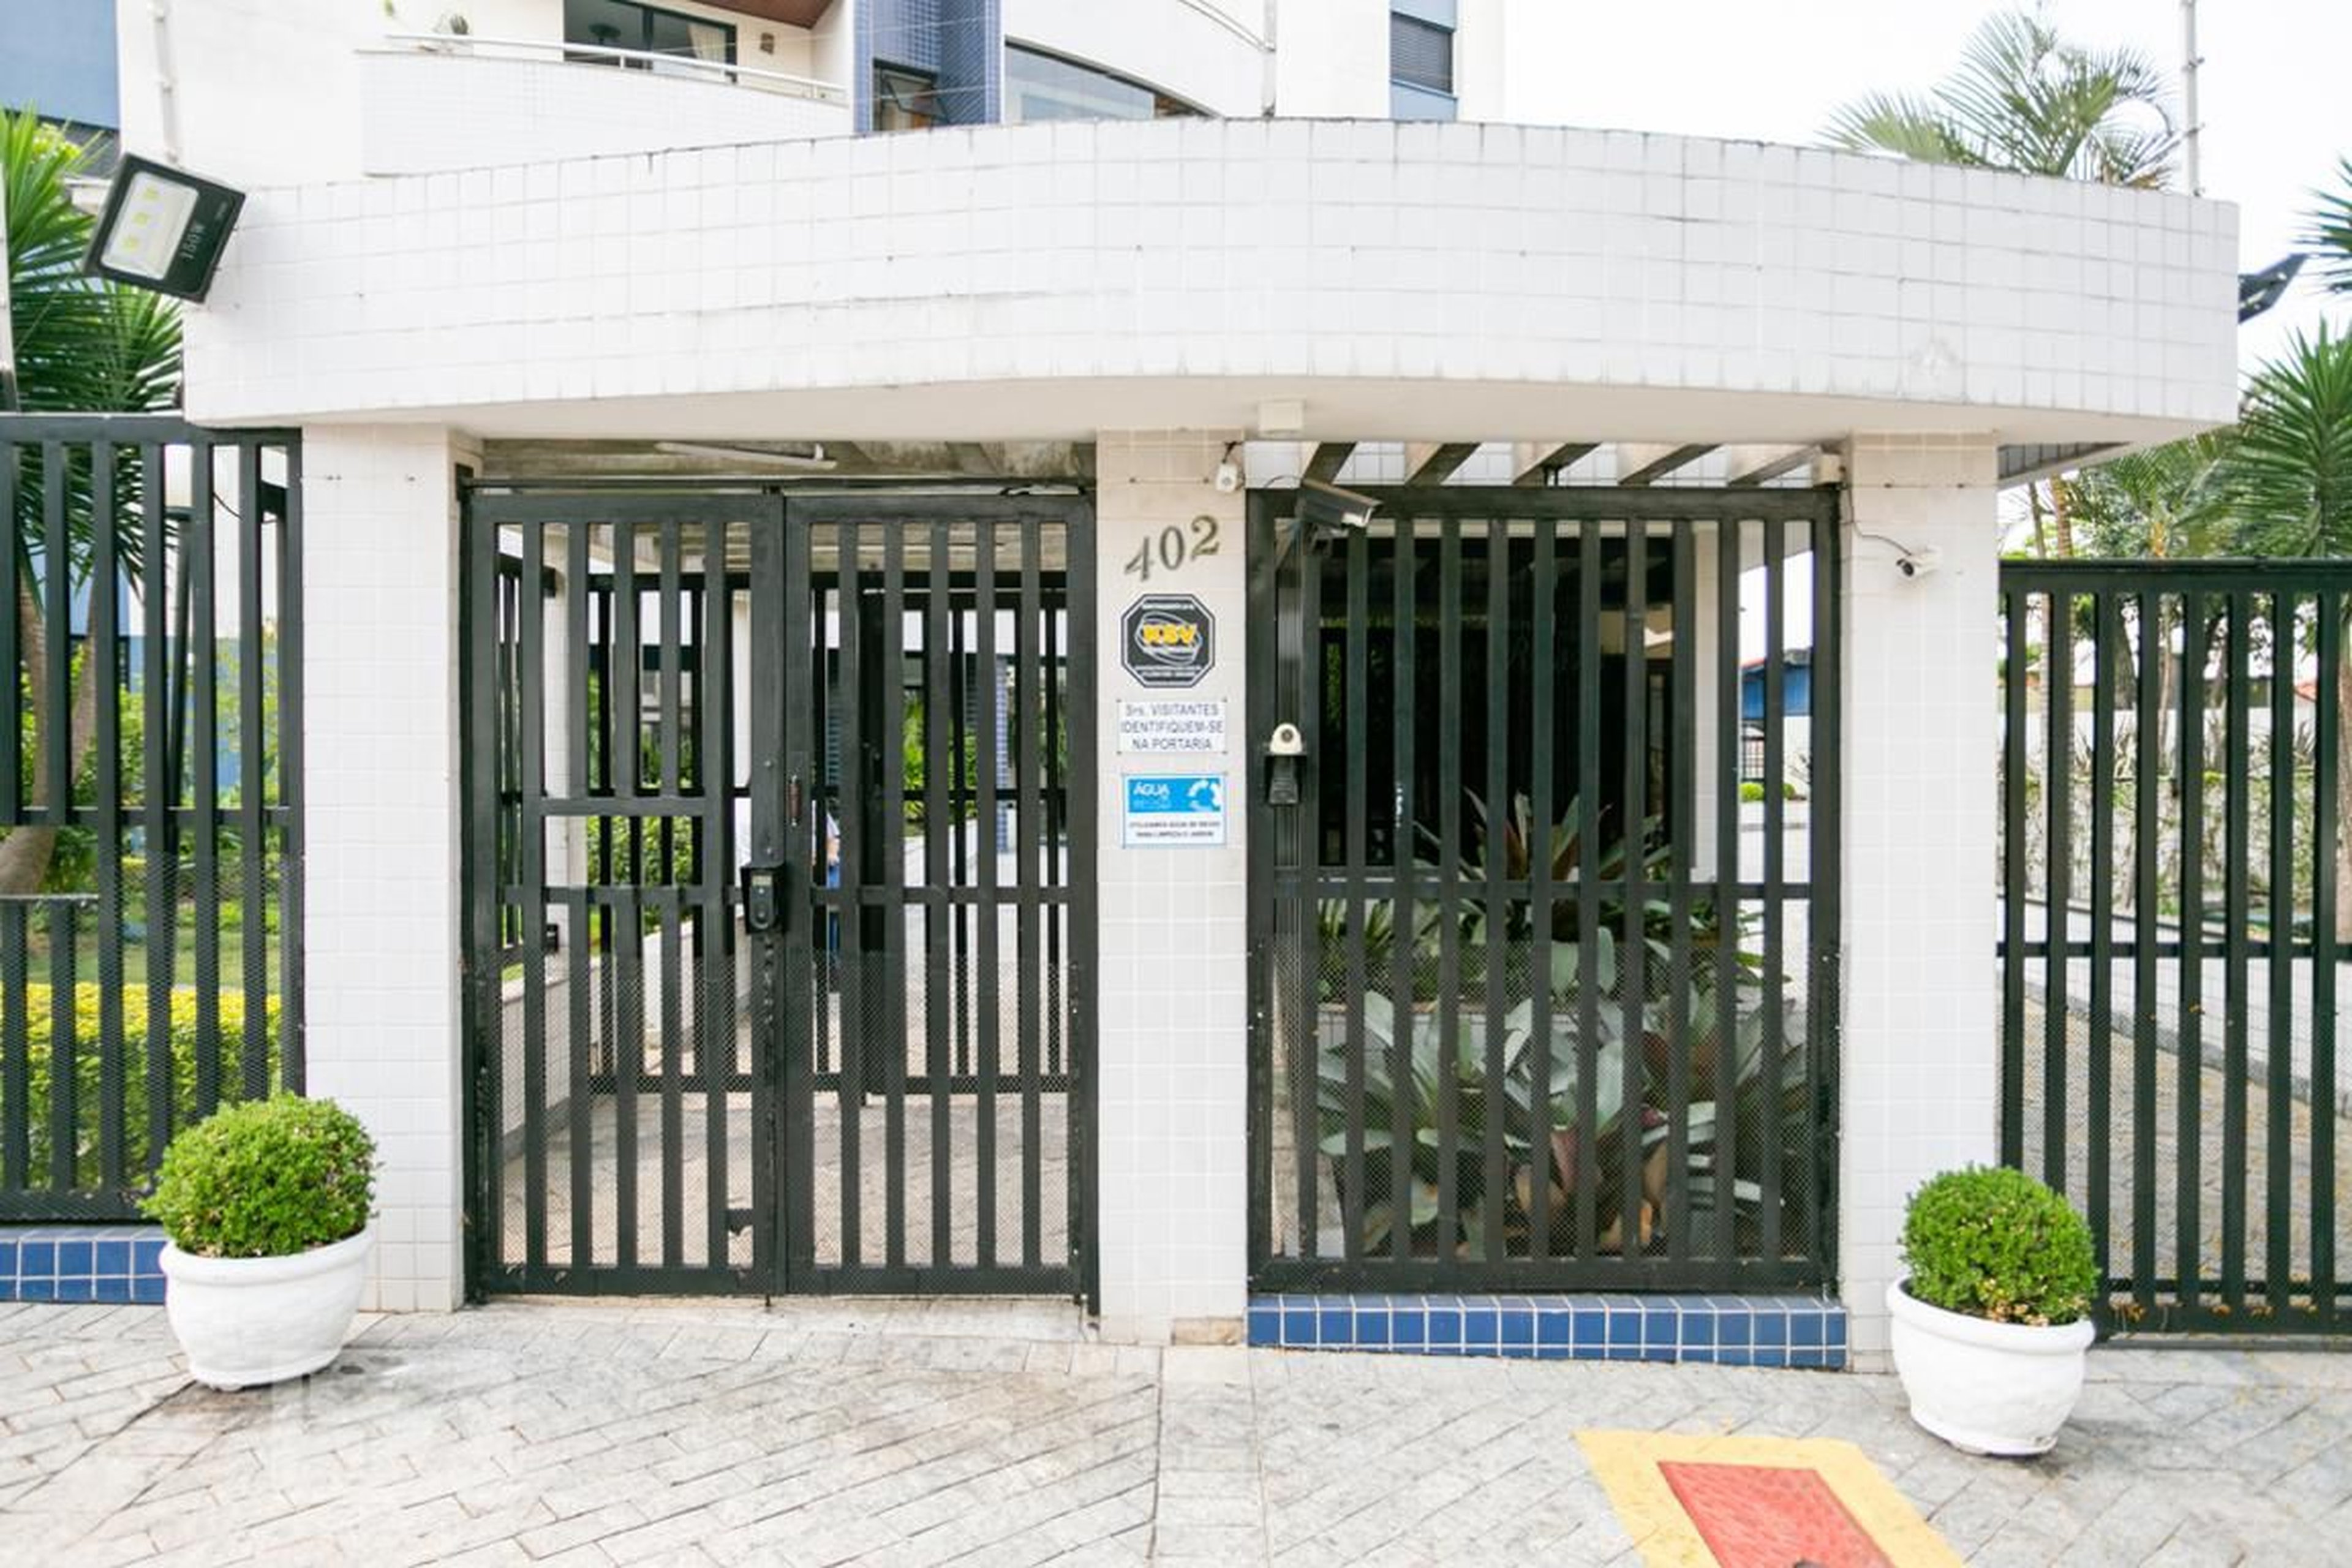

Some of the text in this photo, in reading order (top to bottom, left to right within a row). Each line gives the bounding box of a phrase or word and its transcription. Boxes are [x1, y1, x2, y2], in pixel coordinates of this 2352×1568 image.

[1123, 514, 1220, 581] 402
[1152, 703, 1218, 715] VISITANTES
[1121, 720, 1224, 734] IDENTIFIQUEM-SE
[1133, 738, 1212, 750] NA PORTARIA
